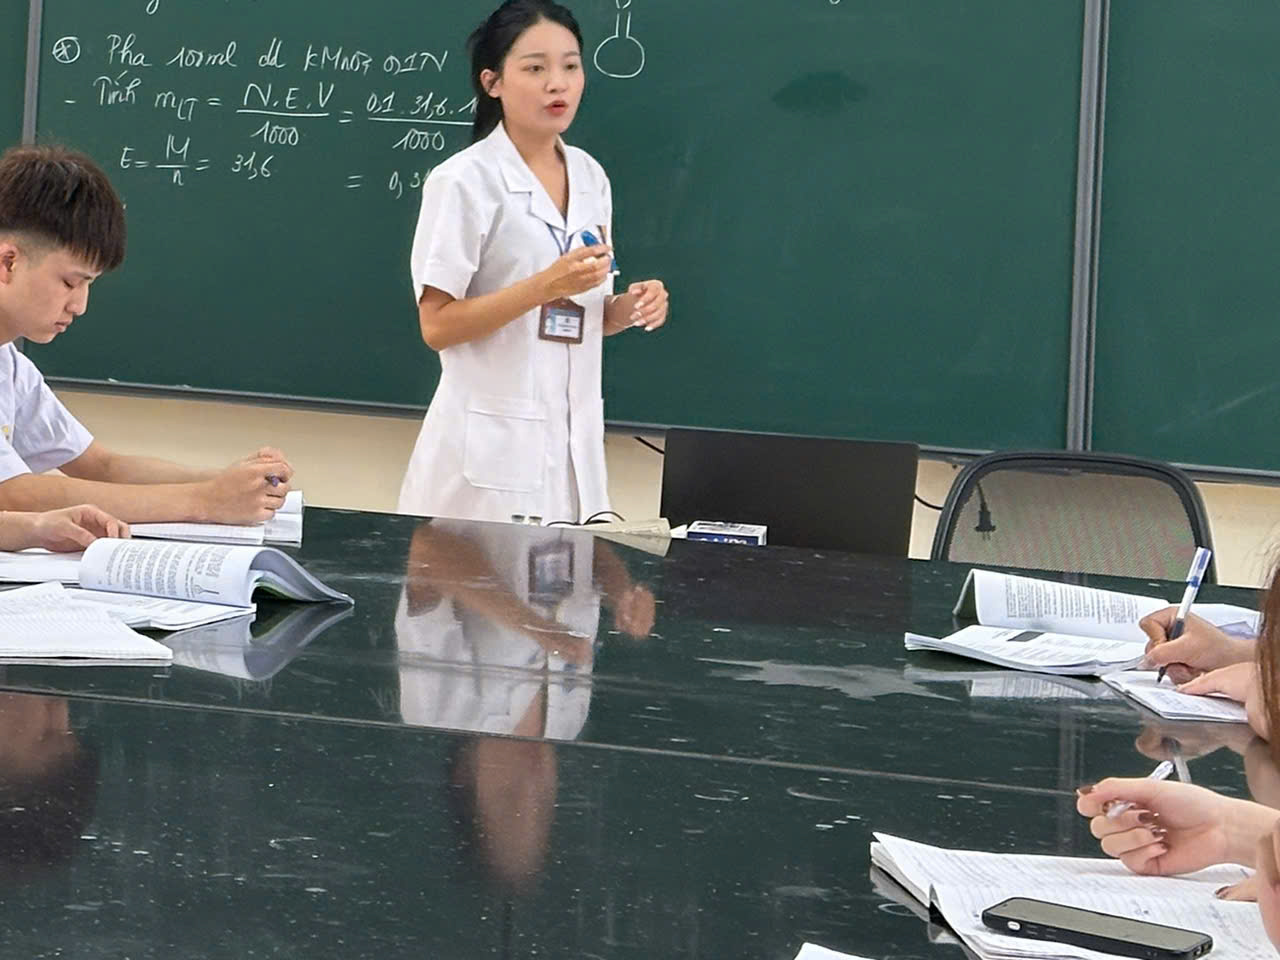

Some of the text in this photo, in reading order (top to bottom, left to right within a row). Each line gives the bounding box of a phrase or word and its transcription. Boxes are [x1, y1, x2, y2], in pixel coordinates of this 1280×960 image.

[106, 32, 153, 66] Pha
[249, 120, 300, 147] 1000
[391, 127, 446, 152] 1000
